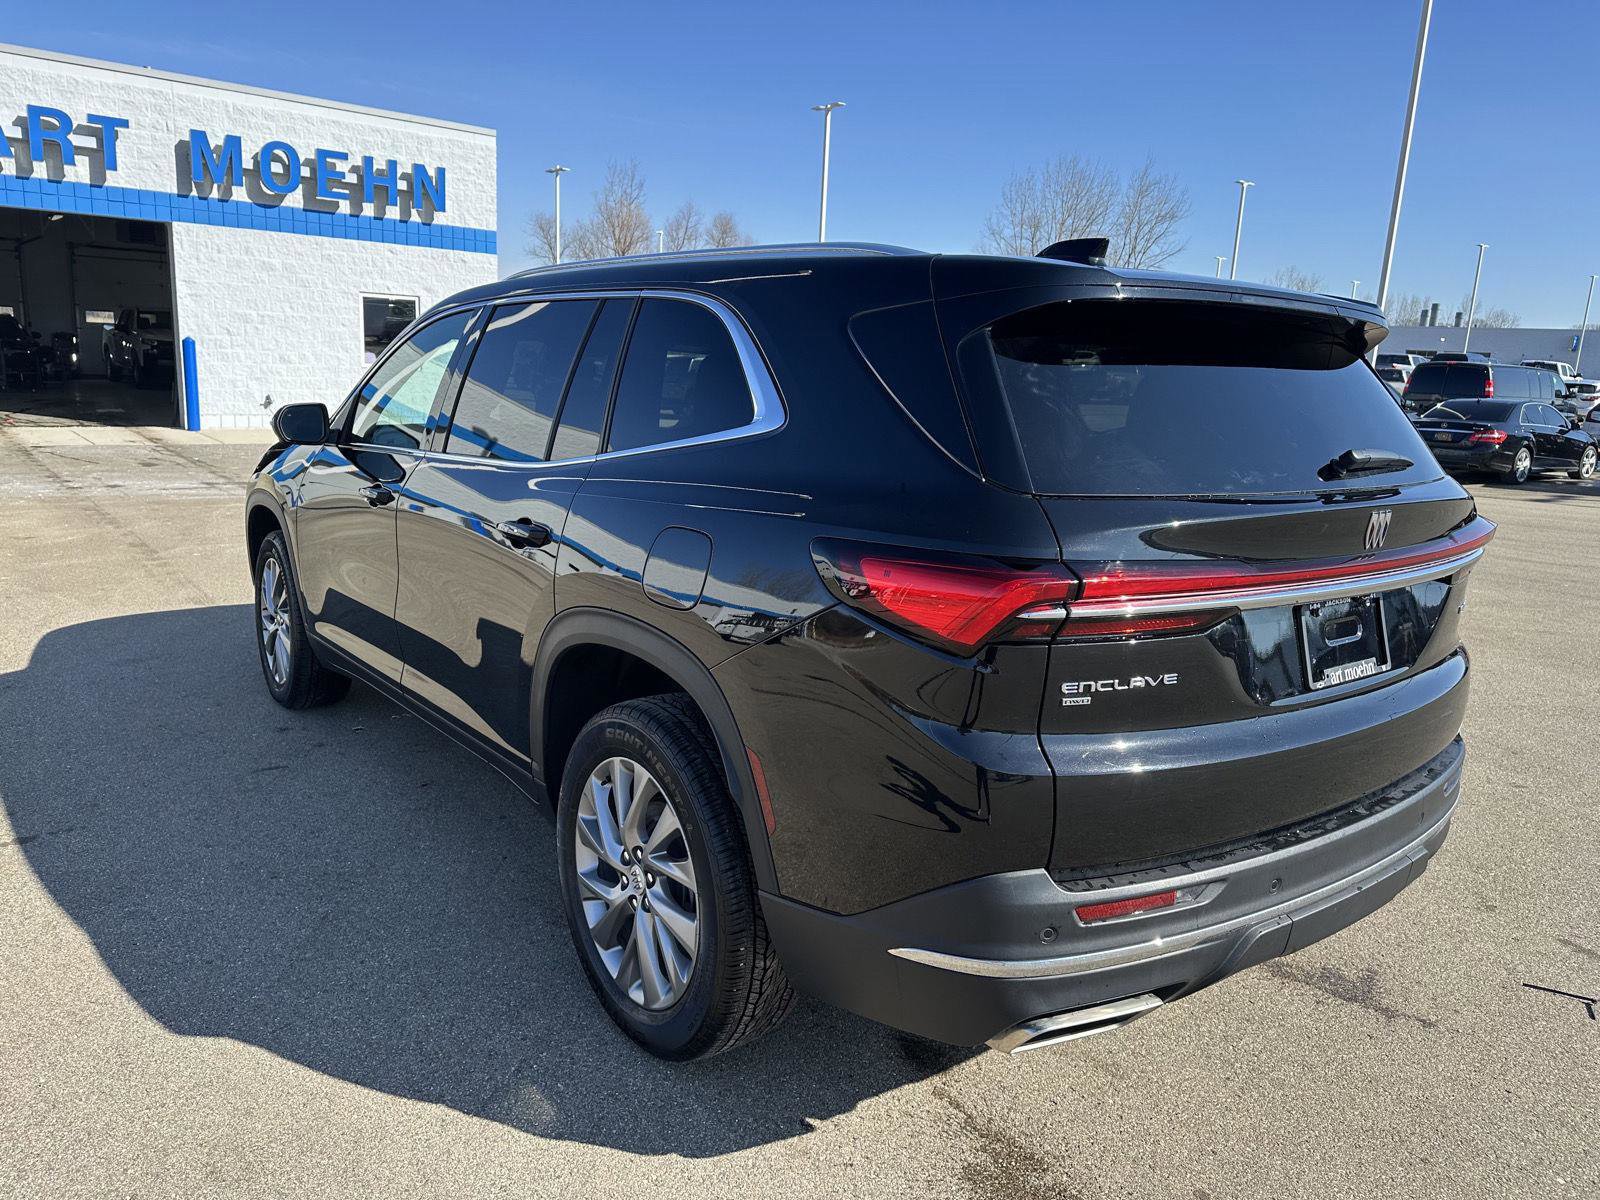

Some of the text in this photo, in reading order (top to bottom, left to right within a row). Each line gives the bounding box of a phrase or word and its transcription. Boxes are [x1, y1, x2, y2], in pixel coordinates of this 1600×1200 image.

[0, 104, 446, 213] RT MOEHN
[1325, 598, 1351, 607] JACKSON
[1061, 673, 1178, 694] ENCLAVE
[1330, 661, 1375, 685] art moehn
[1063, 697, 1091, 706] AWD
